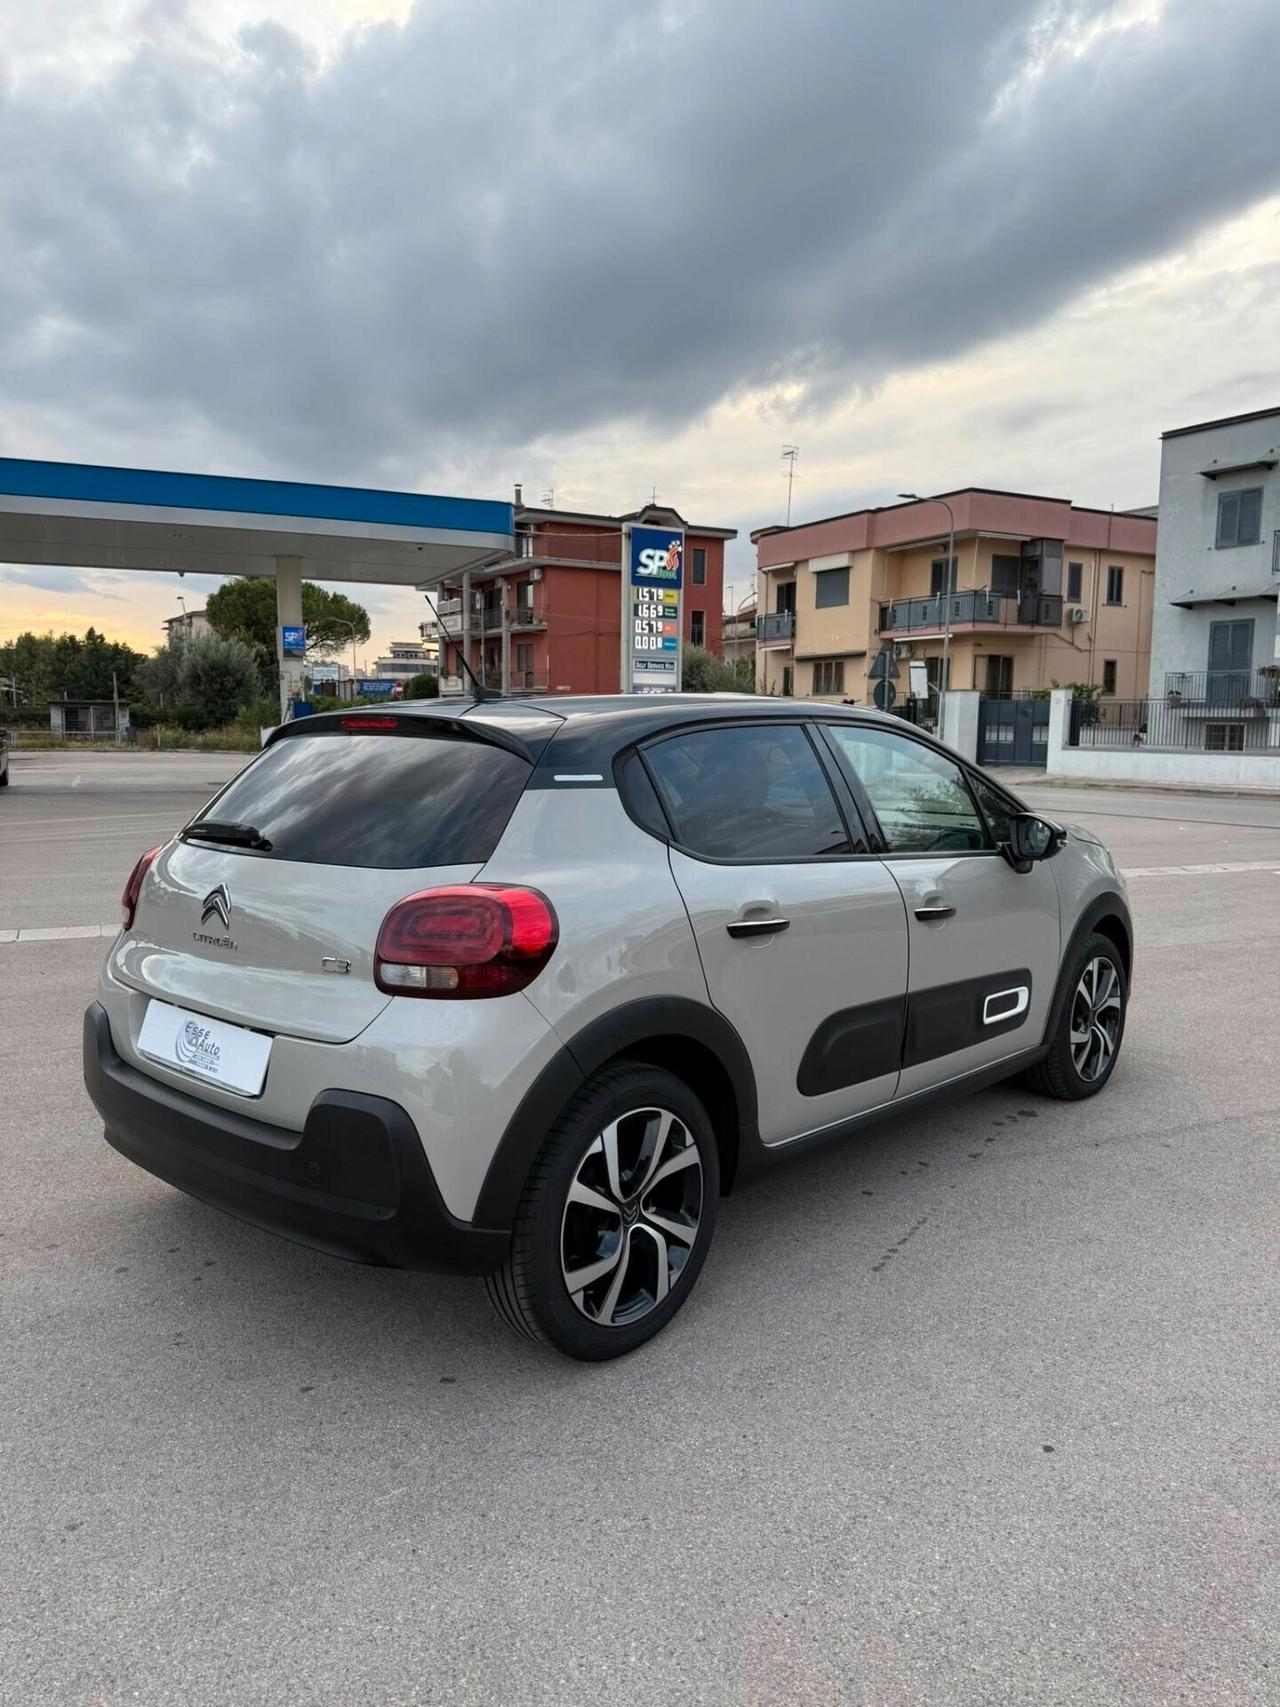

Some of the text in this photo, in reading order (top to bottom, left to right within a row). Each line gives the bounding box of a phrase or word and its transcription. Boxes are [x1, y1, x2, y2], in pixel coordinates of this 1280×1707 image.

[647, 661, 665, 669] SERVICE
[321, 956, 352, 975] C3
[196, 1038, 221, 1056] Auto
